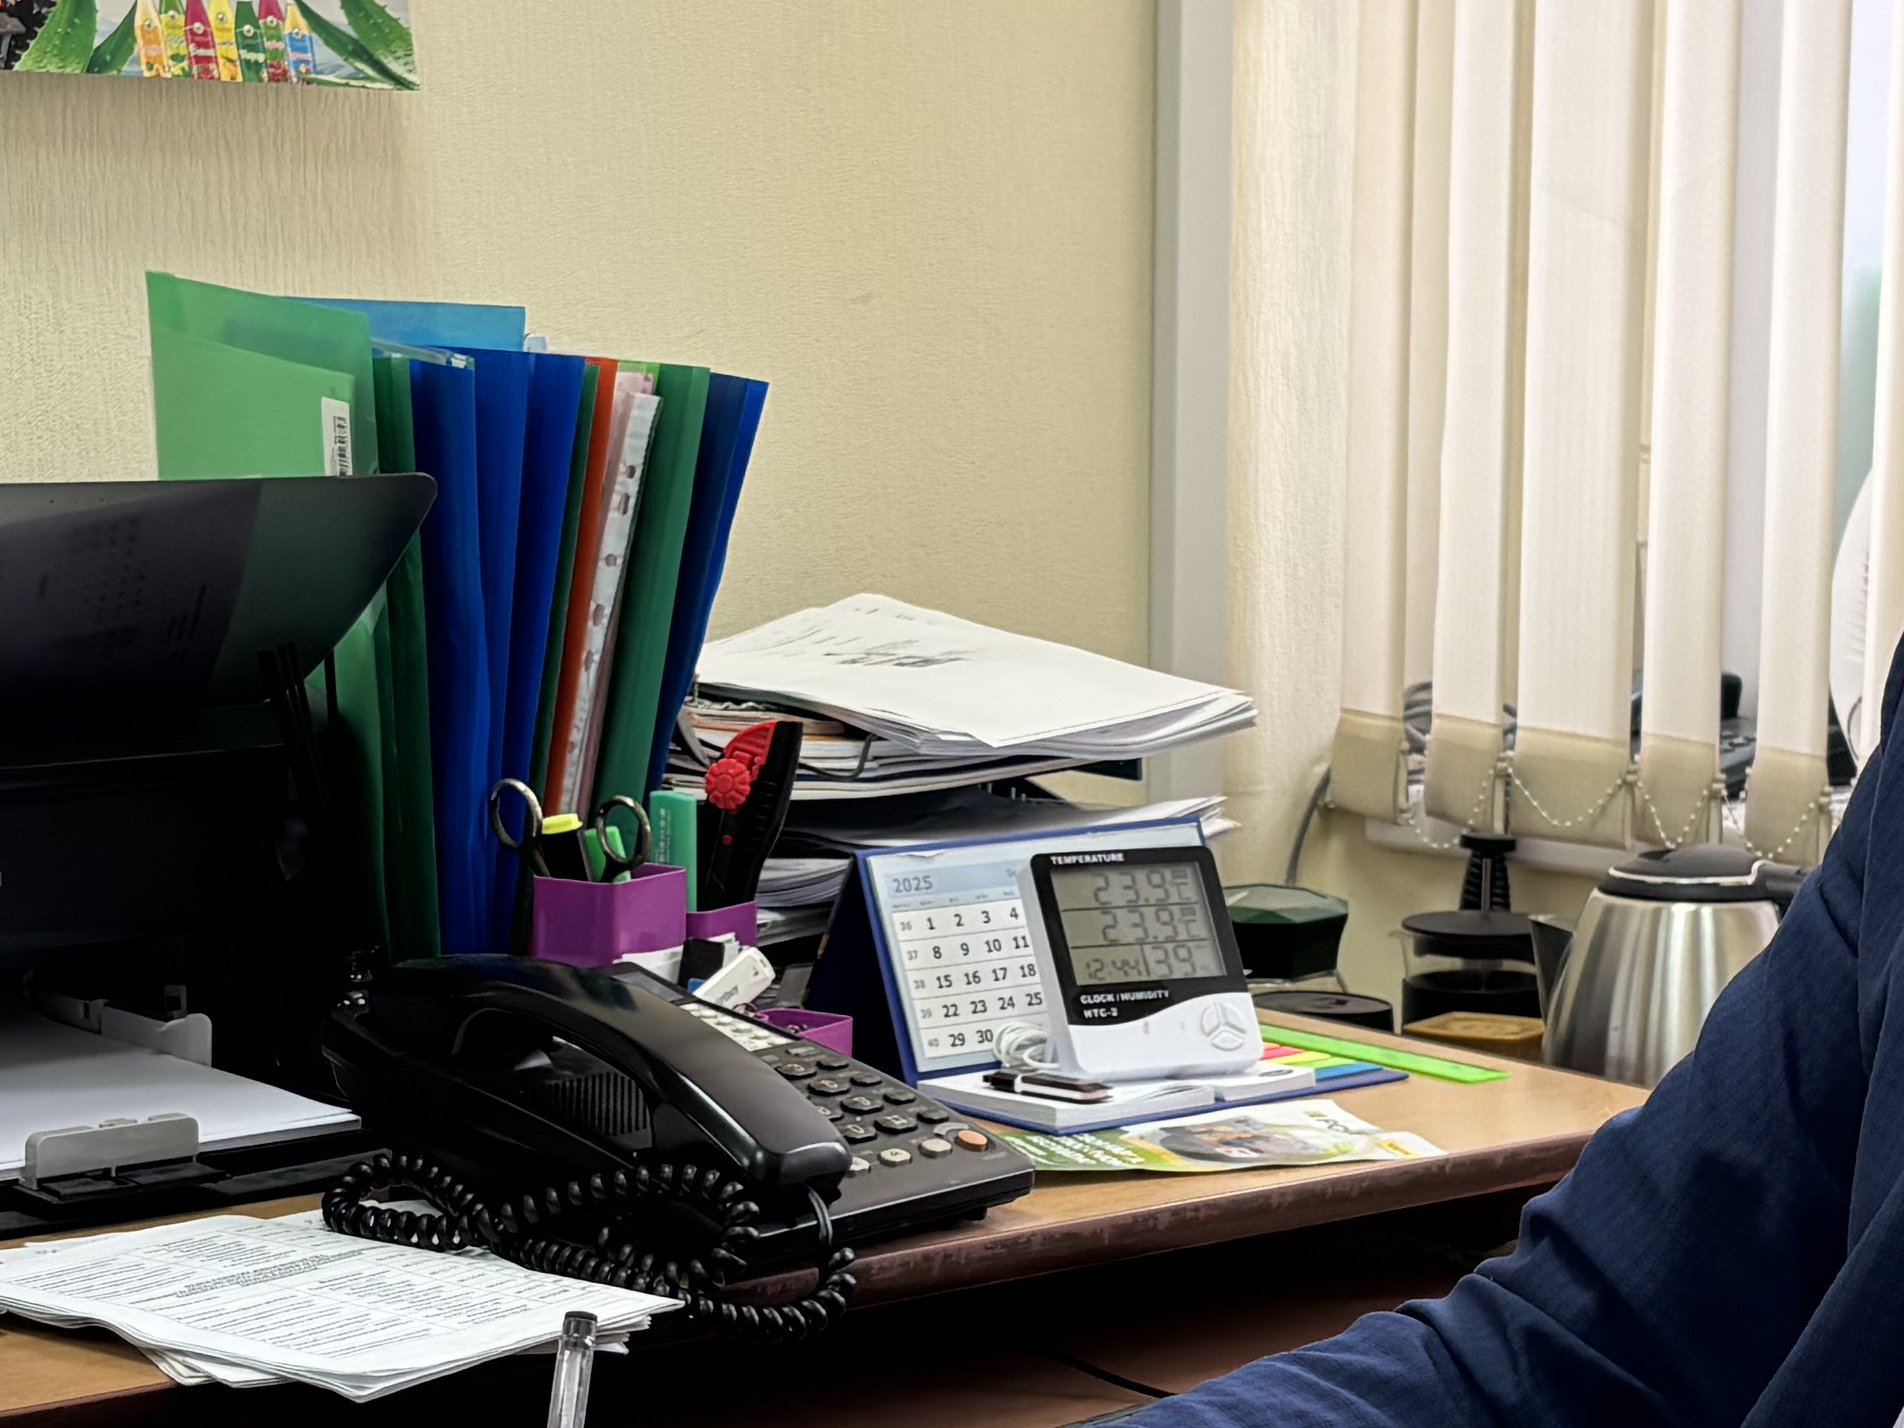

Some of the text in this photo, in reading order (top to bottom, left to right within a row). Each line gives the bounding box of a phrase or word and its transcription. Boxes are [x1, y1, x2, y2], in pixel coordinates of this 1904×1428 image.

[1050, 852, 1125, 867] TEMPERATURE
[893, 875, 933, 894] 2025
[926, 907, 1019, 931] 1 2 3 4
[936, 963, 1036, 989] 15 16 17 18
